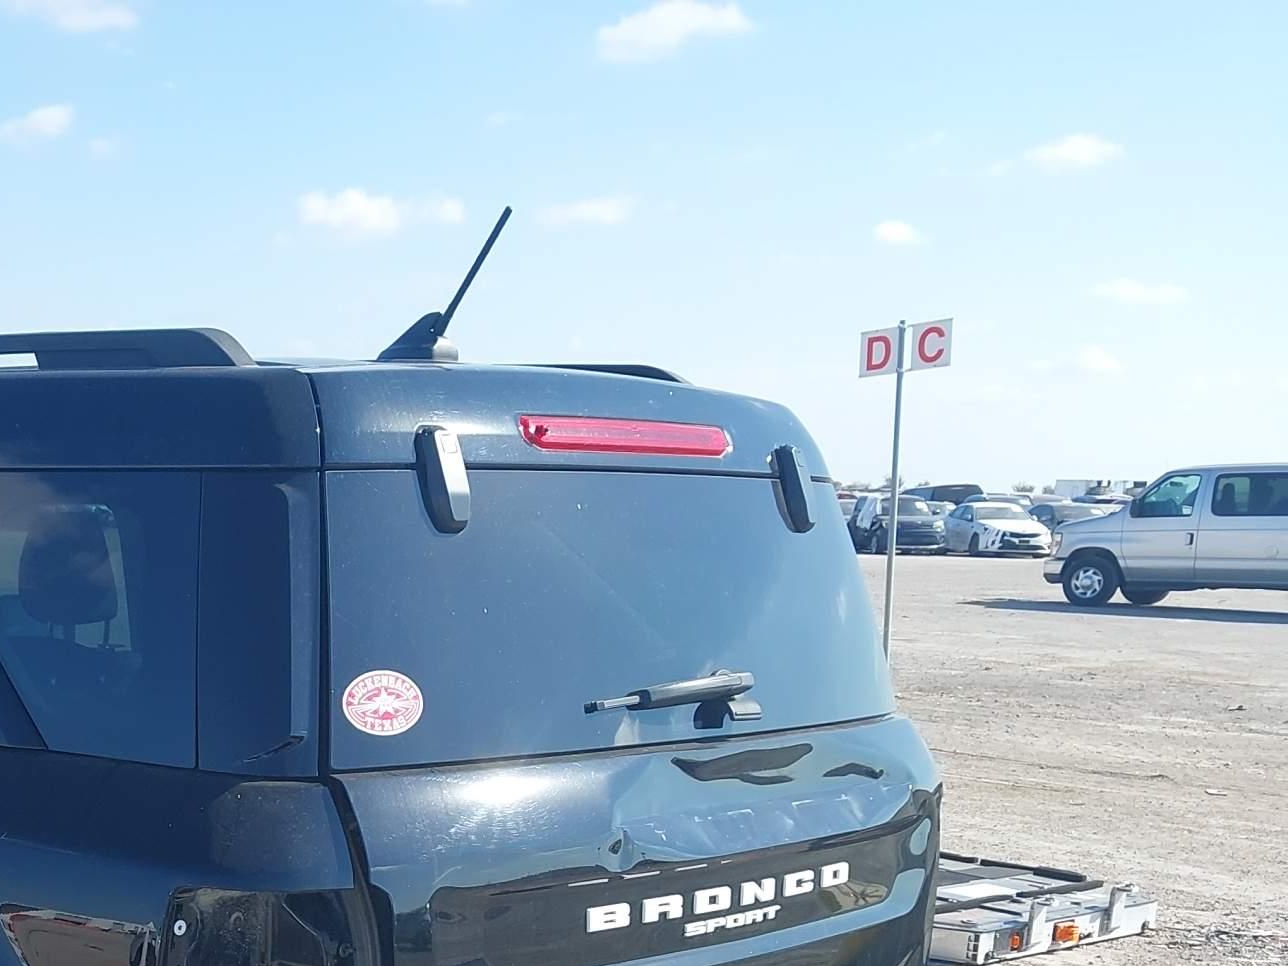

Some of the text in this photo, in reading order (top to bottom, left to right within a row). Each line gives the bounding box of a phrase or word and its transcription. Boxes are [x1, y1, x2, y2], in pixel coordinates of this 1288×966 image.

[866, 335, 892, 371] D
[918, 326, 945, 363] C
[364, 715, 407, 731] TEXAS
[586, 861, 850, 933] BRONCO
[684, 904, 781, 938] SPORT
